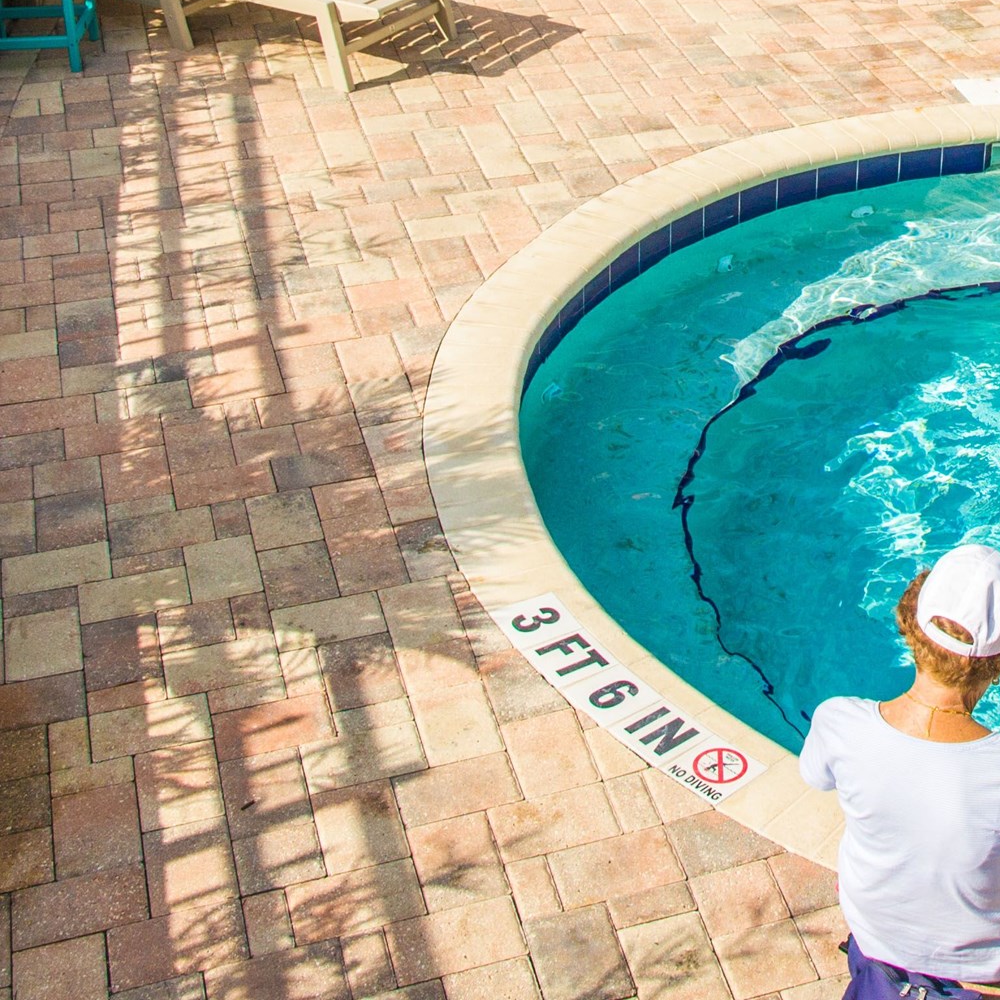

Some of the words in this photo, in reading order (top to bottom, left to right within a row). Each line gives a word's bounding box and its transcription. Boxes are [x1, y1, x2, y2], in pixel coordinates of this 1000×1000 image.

[511, 607, 560, 633] 3
[535, 633, 610, 677] FT
[588, 680, 639, 709] 6
[623, 706, 700, 757] IN
[668, 764, 687, 778] NO
[684, 775, 722, 801] DIVING
